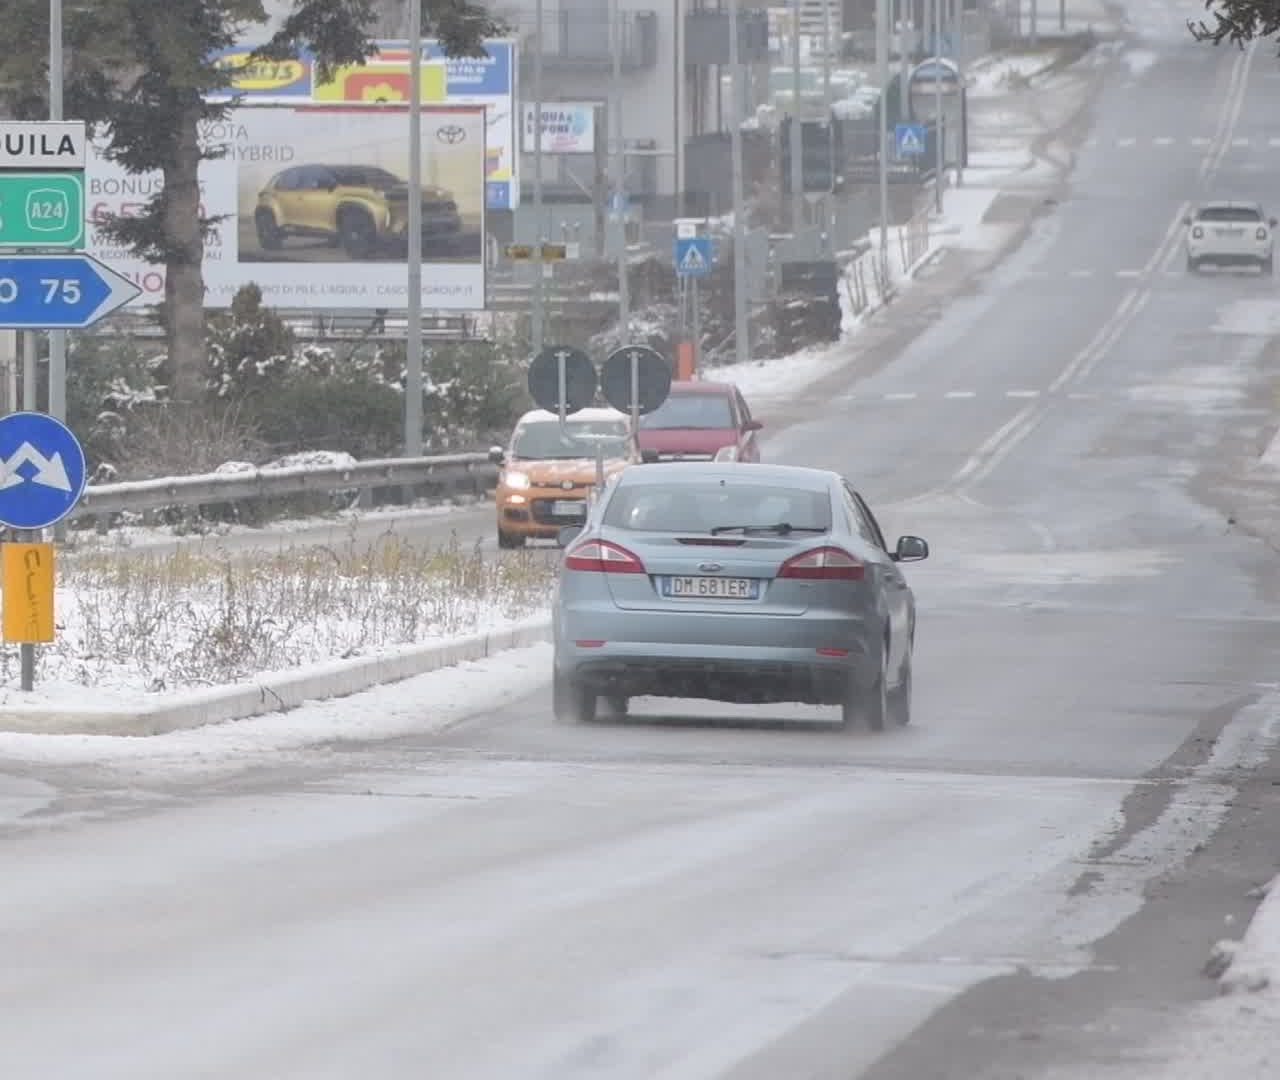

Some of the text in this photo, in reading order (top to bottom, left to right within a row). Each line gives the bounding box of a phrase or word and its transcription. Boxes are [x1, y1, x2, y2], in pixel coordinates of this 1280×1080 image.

[90, 178, 164, 195] BONUS
[31, 201, 63, 219] A24
[40, 278, 81, 305] 75
[674, 578, 693, 593] DM
